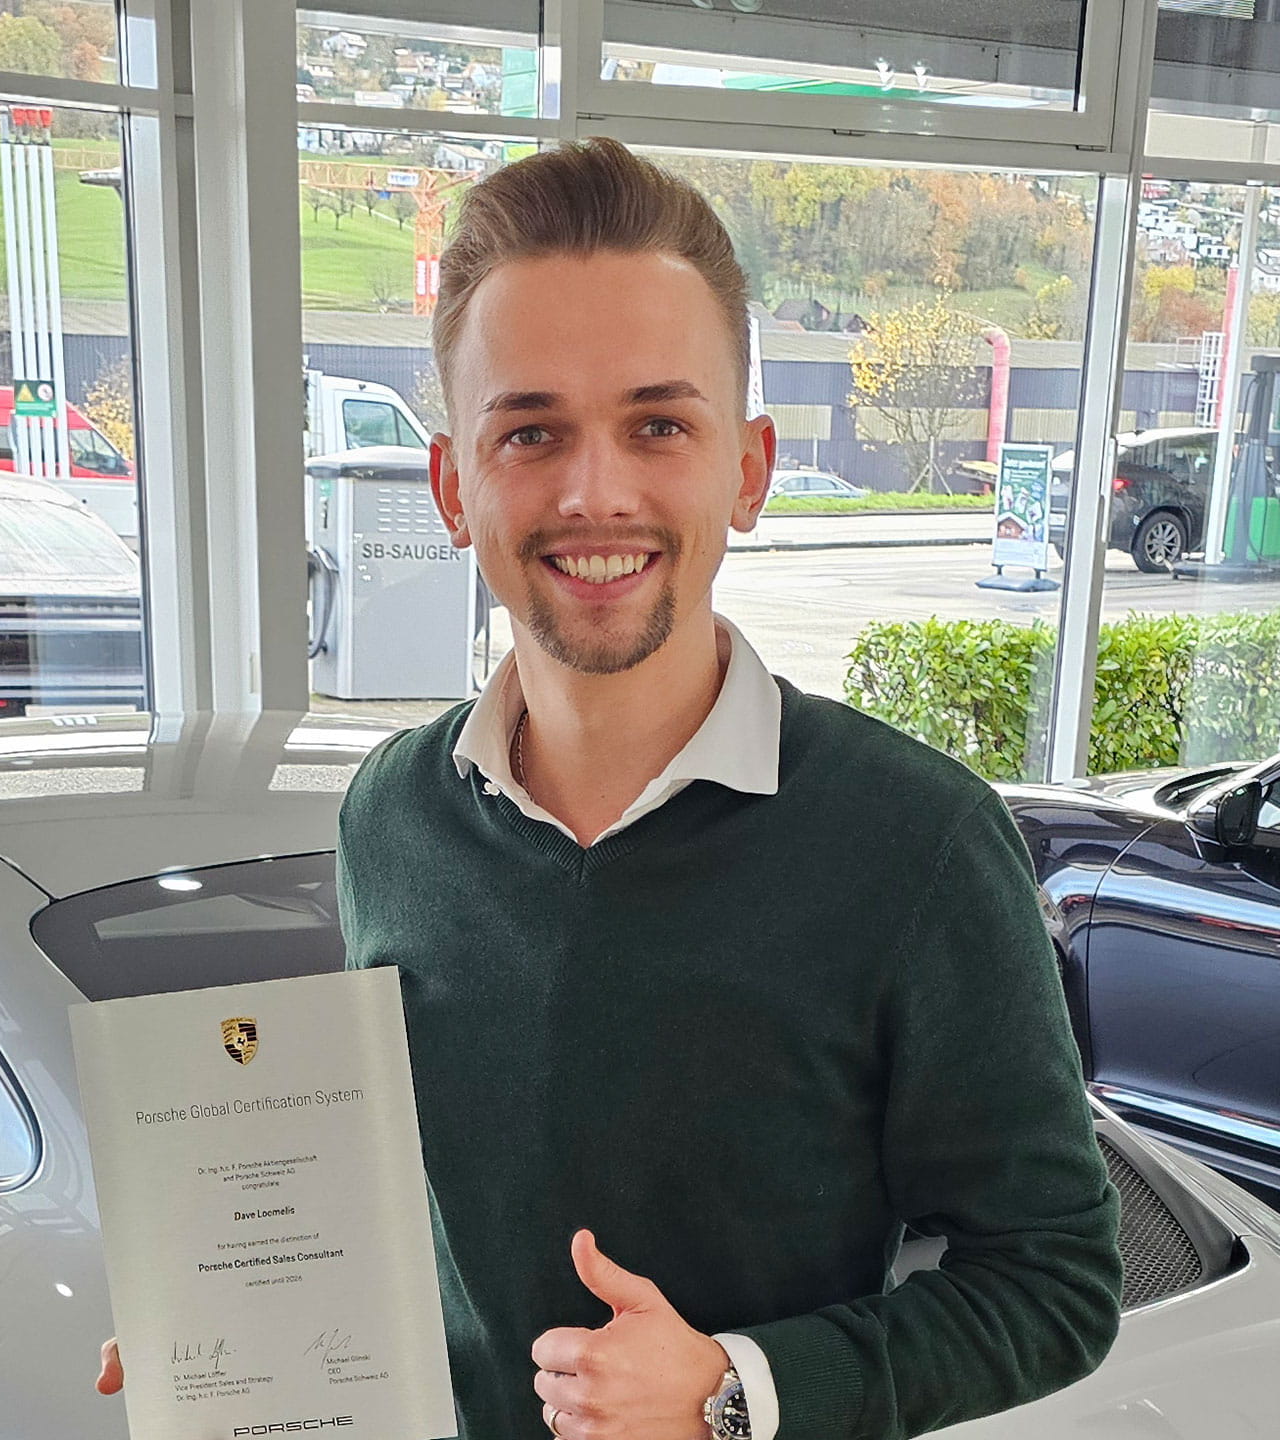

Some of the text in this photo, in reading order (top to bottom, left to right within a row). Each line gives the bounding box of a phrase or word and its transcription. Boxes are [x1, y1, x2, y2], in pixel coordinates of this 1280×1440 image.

[362, 543, 461, 560] SB-SAUGER
[135, 1087, 364, 1125] Porsche Global Certification System
[234, 1211, 256, 1221] Dave
[269, 1237, 280, 1245] the
[198, 1249, 344, 1273] Porsche Certified Sales Consultant
[233, 1415, 354, 1437] PORSCHE
